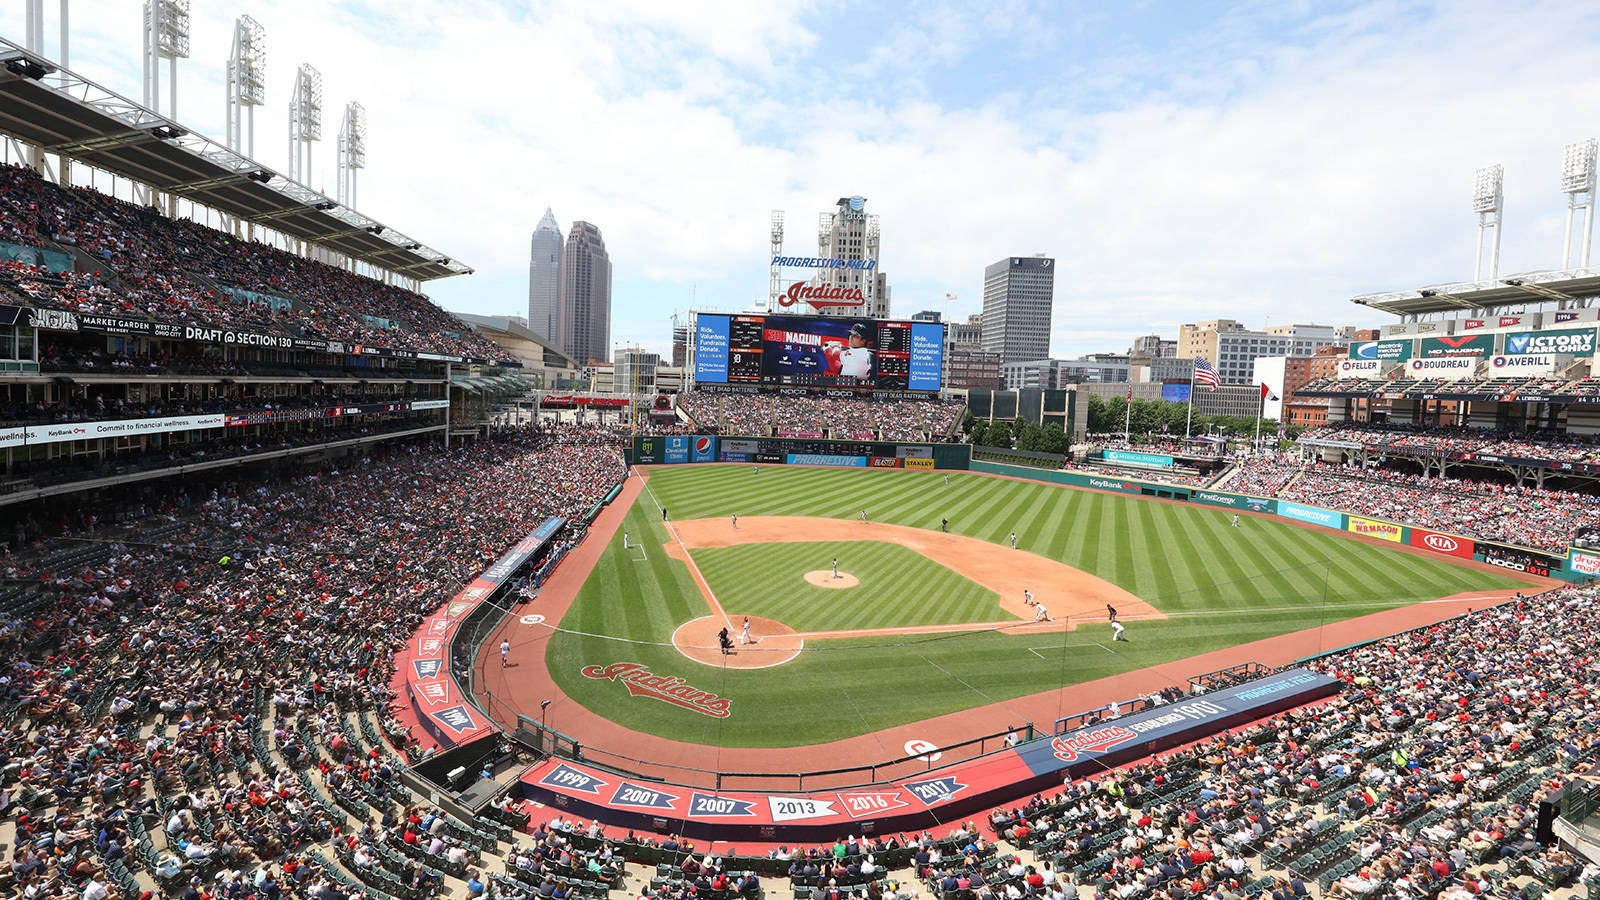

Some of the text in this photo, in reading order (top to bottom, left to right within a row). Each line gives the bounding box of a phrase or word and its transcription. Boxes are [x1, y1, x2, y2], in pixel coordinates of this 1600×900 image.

[771, 256, 876, 270] PROGRESSIVE FIELD
[778, 281, 865, 310] Indians
[83, 316, 150, 330] MARKET GARDEN
[186, 326, 292, 348] DRAFT @ SECTION 130
[785, 332, 821, 346] NAQUIN
[1558, 344, 1592, 352] OHIO
[1351, 362, 1377, 370] FELLER
[1424, 360, 1469, 368] BOUDREAU
[1507, 357, 1550, 366] AVERILL
[97, 424, 125, 432] Commit
[135, 420, 162, 429] financial
[792, 455, 859, 466] PROGRESSIVE
[1090, 479, 1122, 489] KeyBank
[1200, 493, 1235, 505] FirstEnergy
[1285, 506, 1331, 522] PROGRESSIVE
[1429, 537, 1452, 549] KIA
[1486, 556, 1548, 576] NOCO 1914
[581, 662, 732, 718] Indians
[1051, 700, 1228, 761] Indians ESTABLISHED 1901
[553, 770, 590, 787] 1999
[620, 788, 660, 805] 2001
[914, 780, 950, 799] 2017
[696, 797, 736, 813] 2007
[777, 801, 816, 814] 2013
[848, 795, 888, 811] 2016
